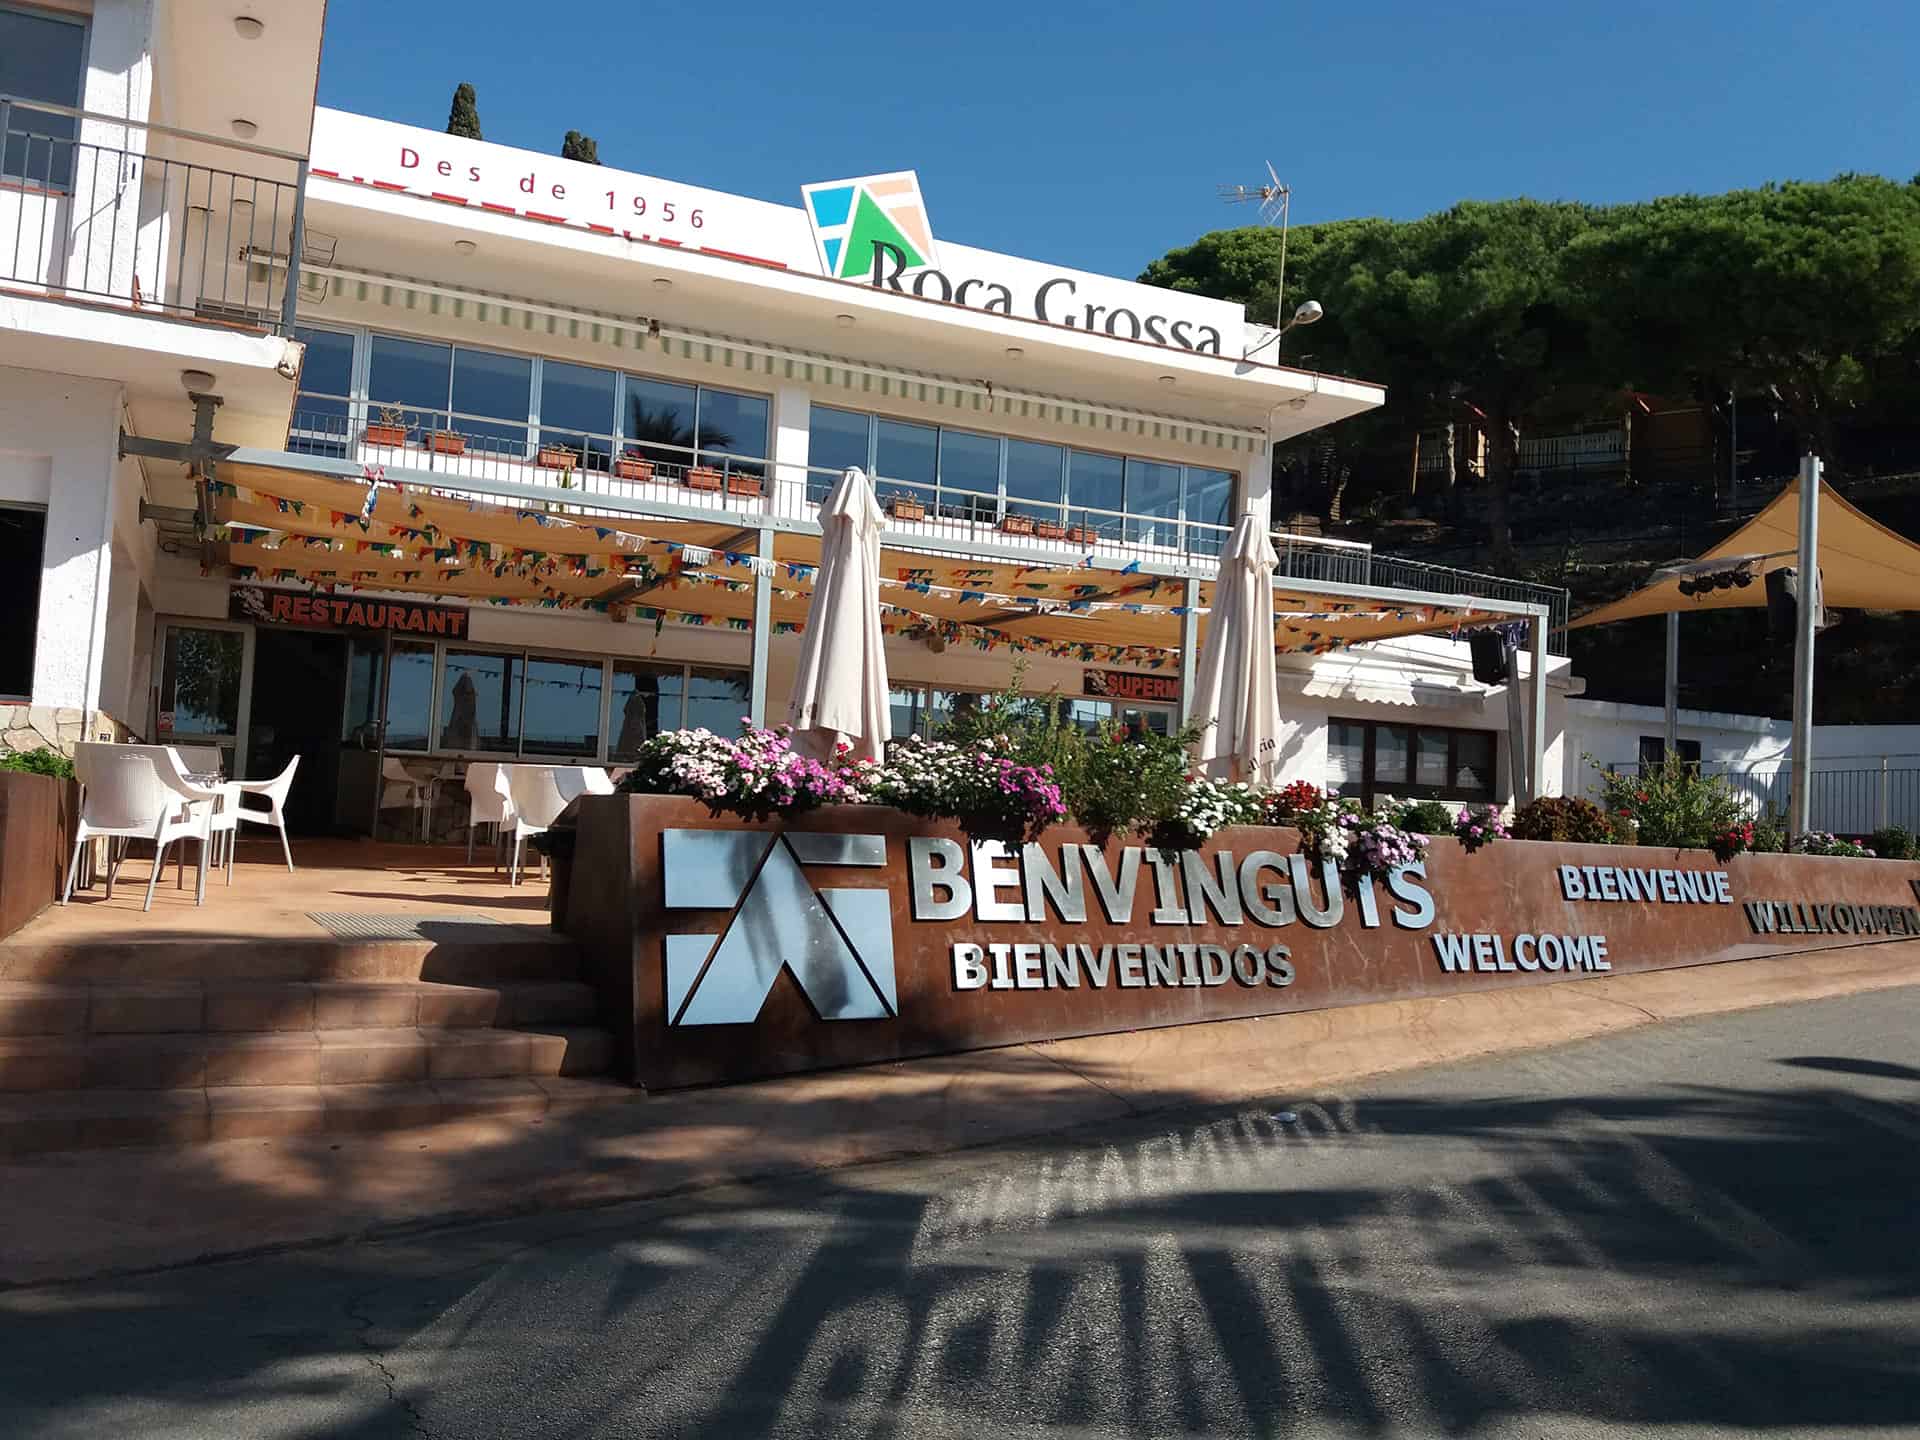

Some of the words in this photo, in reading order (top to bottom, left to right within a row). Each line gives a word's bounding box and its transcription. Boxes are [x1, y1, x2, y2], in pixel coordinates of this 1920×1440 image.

[400, 147, 482, 183] Des
[518, 172, 567, 200] de
[605, 190, 704, 229] 1956
[870, 239, 1013, 316] Roca
[1034, 278, 1221, 356] Grossa
[271, 593, 466, 635] RESTAURANT
[1560, 863, 1735, 904] BIENVENUE
[1744, 902, 1920, 936] WILLKOMMEN
[952, 942, 1297, 990] BIENVENIDOS
[1433, 932, 1612, 972] WELCOME
